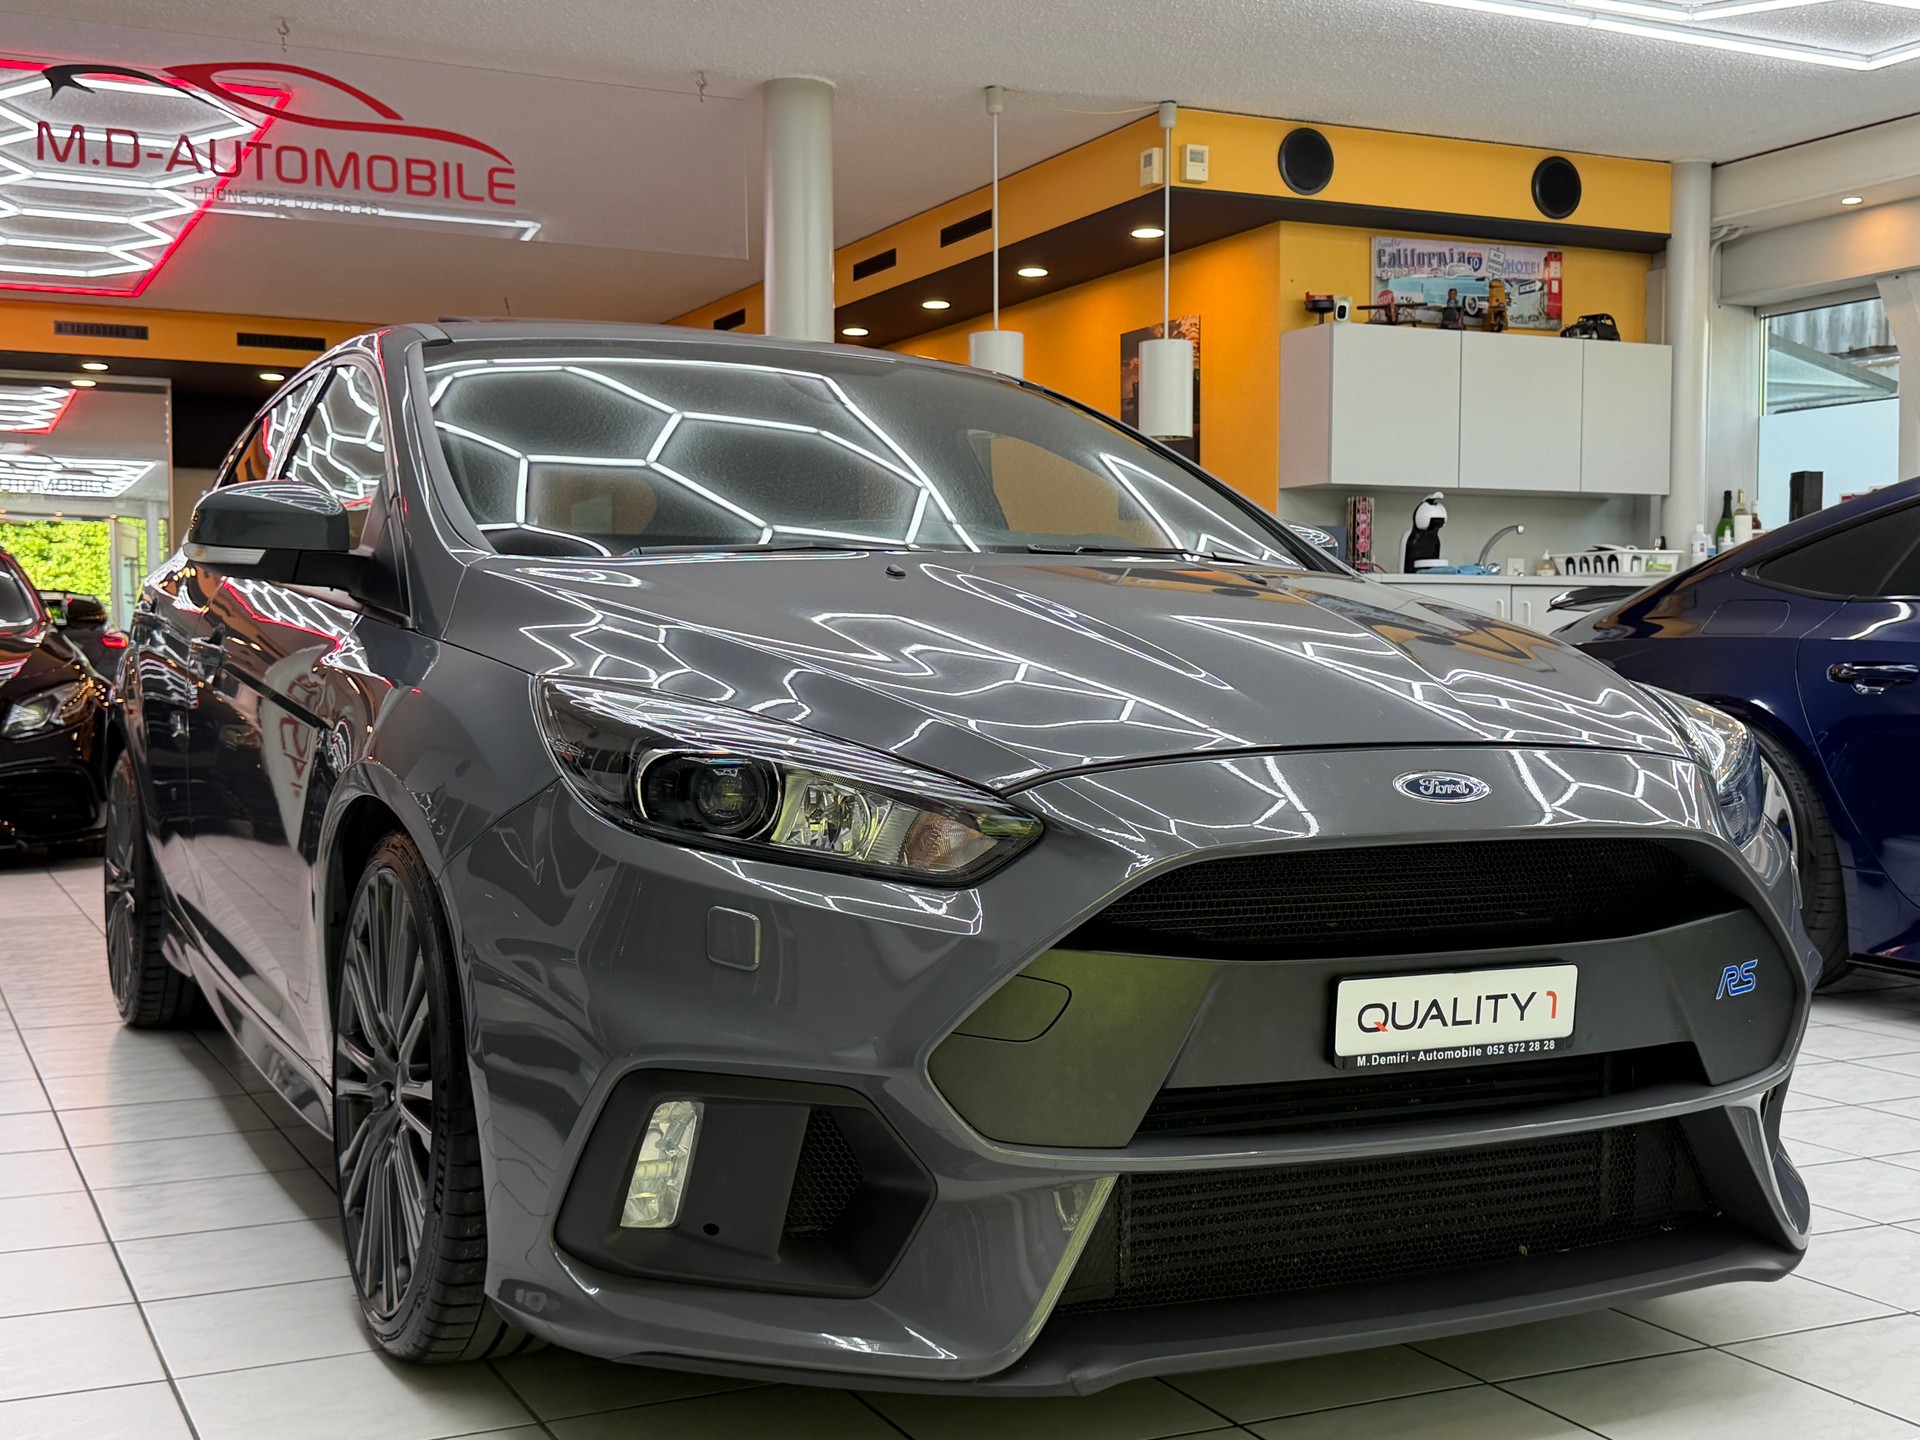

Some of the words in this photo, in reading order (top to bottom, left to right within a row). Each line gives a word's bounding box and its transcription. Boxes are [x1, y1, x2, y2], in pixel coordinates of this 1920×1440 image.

[37, 120, 516, 205] M.D-AUTOMOBILE
[1377, 247, 1466, 268] California
[1419, 776, 1470, 796] Ford
[1715, 958, 1759, 1001] RS
[1357, 991, 1538, 1033] QUALITY
[1546, 990, 1558, 1019] 1
[1417, 1046, 1482, 1062] Automobile
[1486, 1045, 1505, 1056] 052
[1508, 1043, 1526, 1054] 672
[1529, 1041, 1540, 1052] 28
[1543, 1040, 1555, 1050] 28
